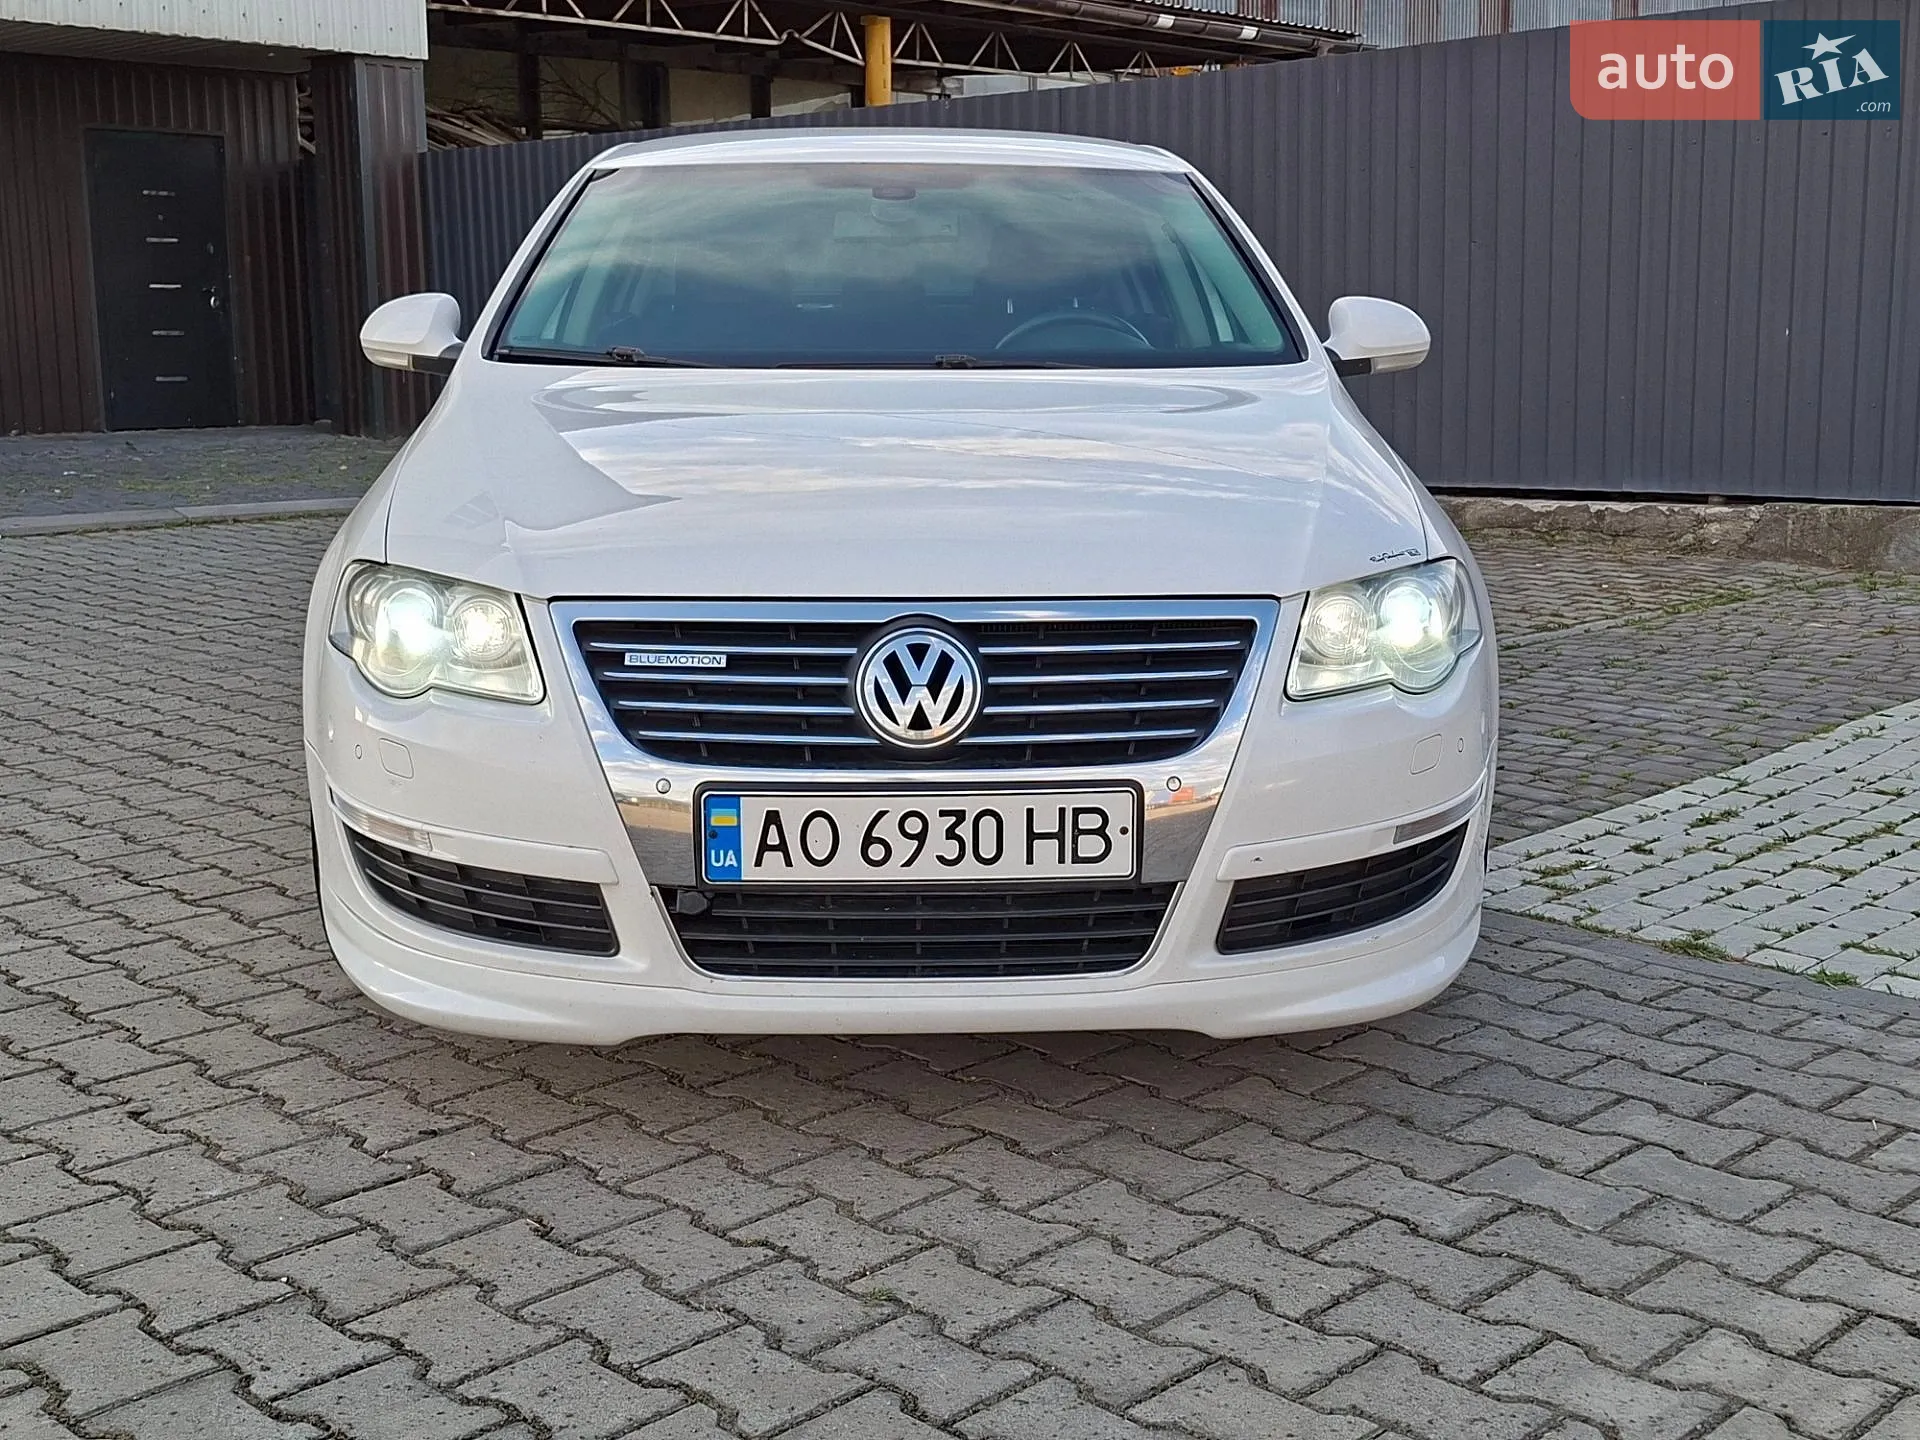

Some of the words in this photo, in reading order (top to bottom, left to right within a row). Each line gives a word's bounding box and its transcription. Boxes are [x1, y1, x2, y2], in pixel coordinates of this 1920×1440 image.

[629, 654, 723, 665] BLUEMOTION
[865, 634, 973, 739] VW
[753, 808, 841, 868] AO
[859, 808, 1004, 868] 6930
[1024, 806, 1112, 866] HB
[711, 850, 738, 868] UA
